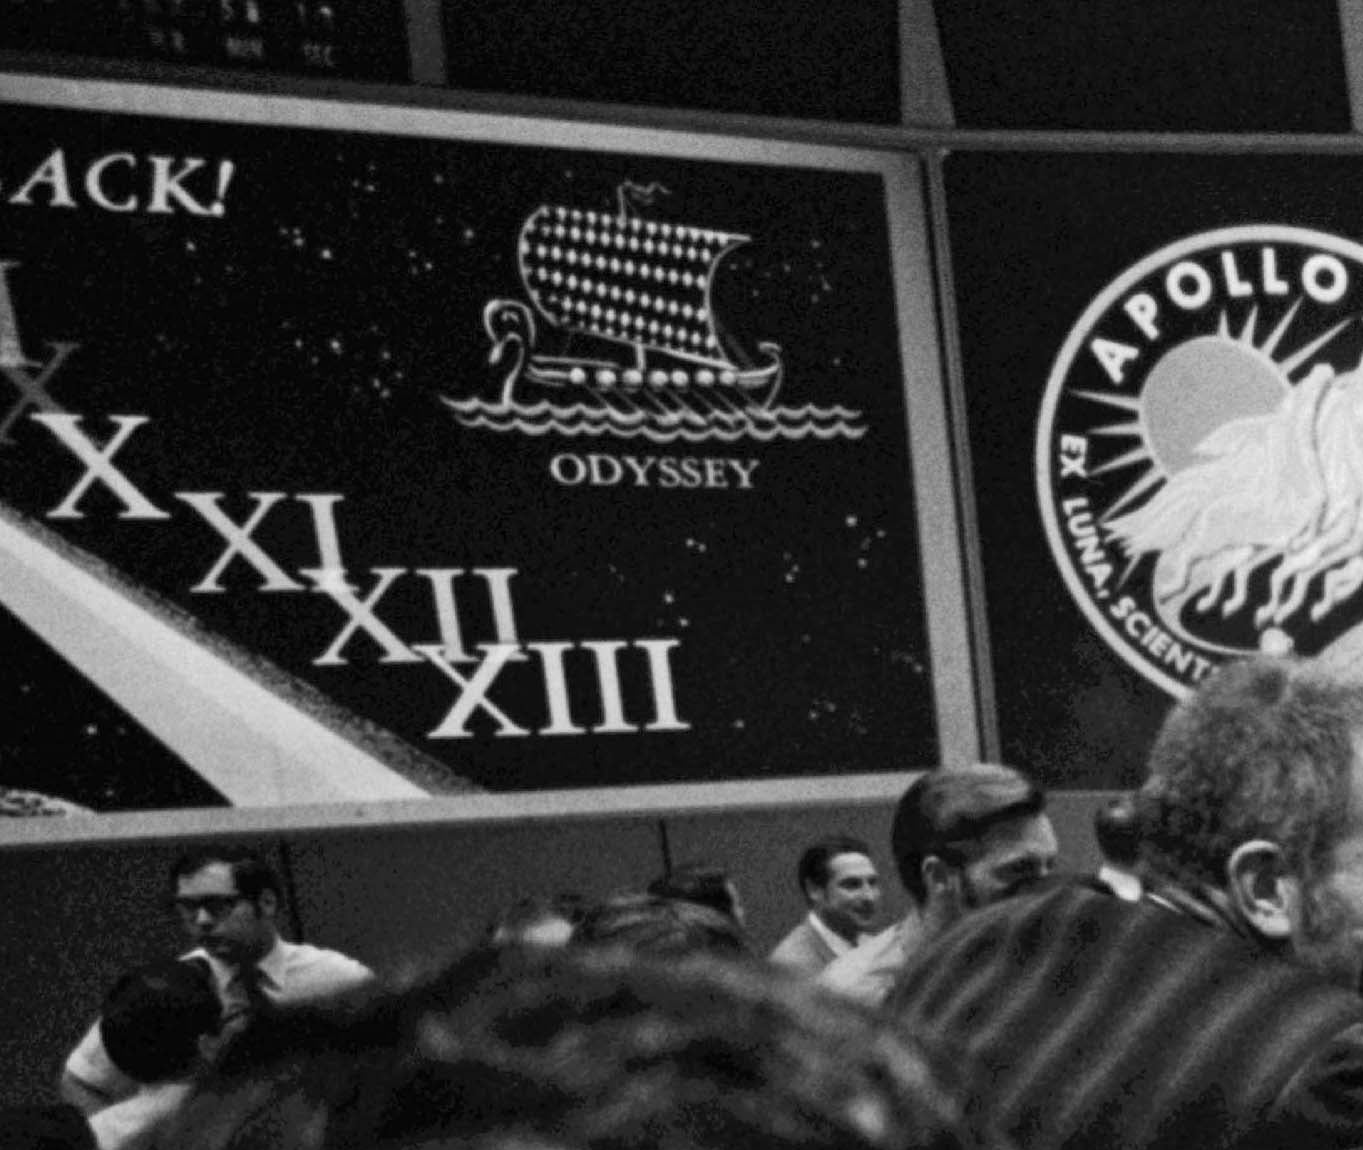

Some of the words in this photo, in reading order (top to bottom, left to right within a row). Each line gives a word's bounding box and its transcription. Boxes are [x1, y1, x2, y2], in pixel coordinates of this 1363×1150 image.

[1090, 246, 1348, 385] APOLLO
[29, 412, 172, 520] X
[549, 452, 761, 491] ODYSSEY
[174, 491, 358, 594] XI
[1059, 433, 1088, 480] EX
[1109, 595, 1219, 682] SCIENT
[298, 567, 530, 666] XII
[412, 638, 691, 740] XIII
